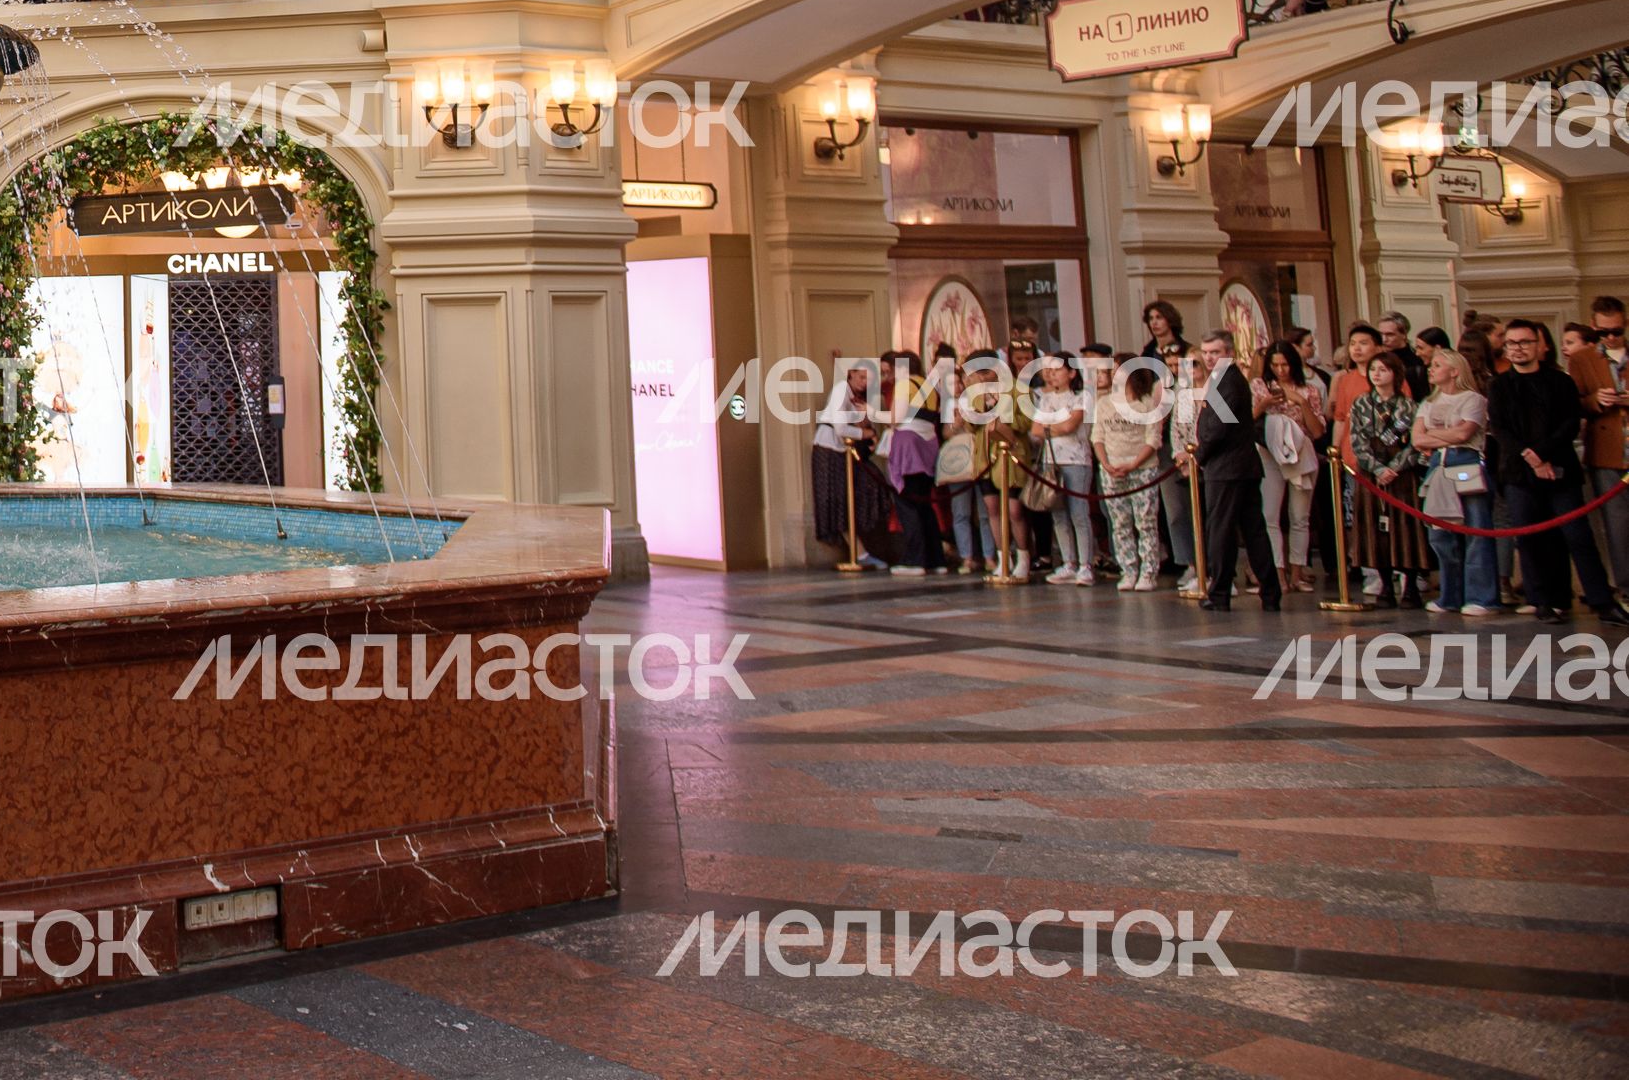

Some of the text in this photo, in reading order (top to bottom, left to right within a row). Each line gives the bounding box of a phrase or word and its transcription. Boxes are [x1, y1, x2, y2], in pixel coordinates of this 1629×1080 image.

[1079, 24, 1104, 42] НА
[1136, 6, 1209, 33] ЛИНИЮ
[1106, 42, 1186, 62] TO THE 1-ST LINE
[629, 188, 703, 201] АРТИКОЛИ
[101, 196, 255, 225] АРТИКОЛИ
[942, 196, 1014, 212] АРТИКОЛИ
[1233, 204, 1291, 219] АРТИКОЛИ
[167, 252, 274, 274] CHANEL
[630, 383, 675, 397] HANEL
